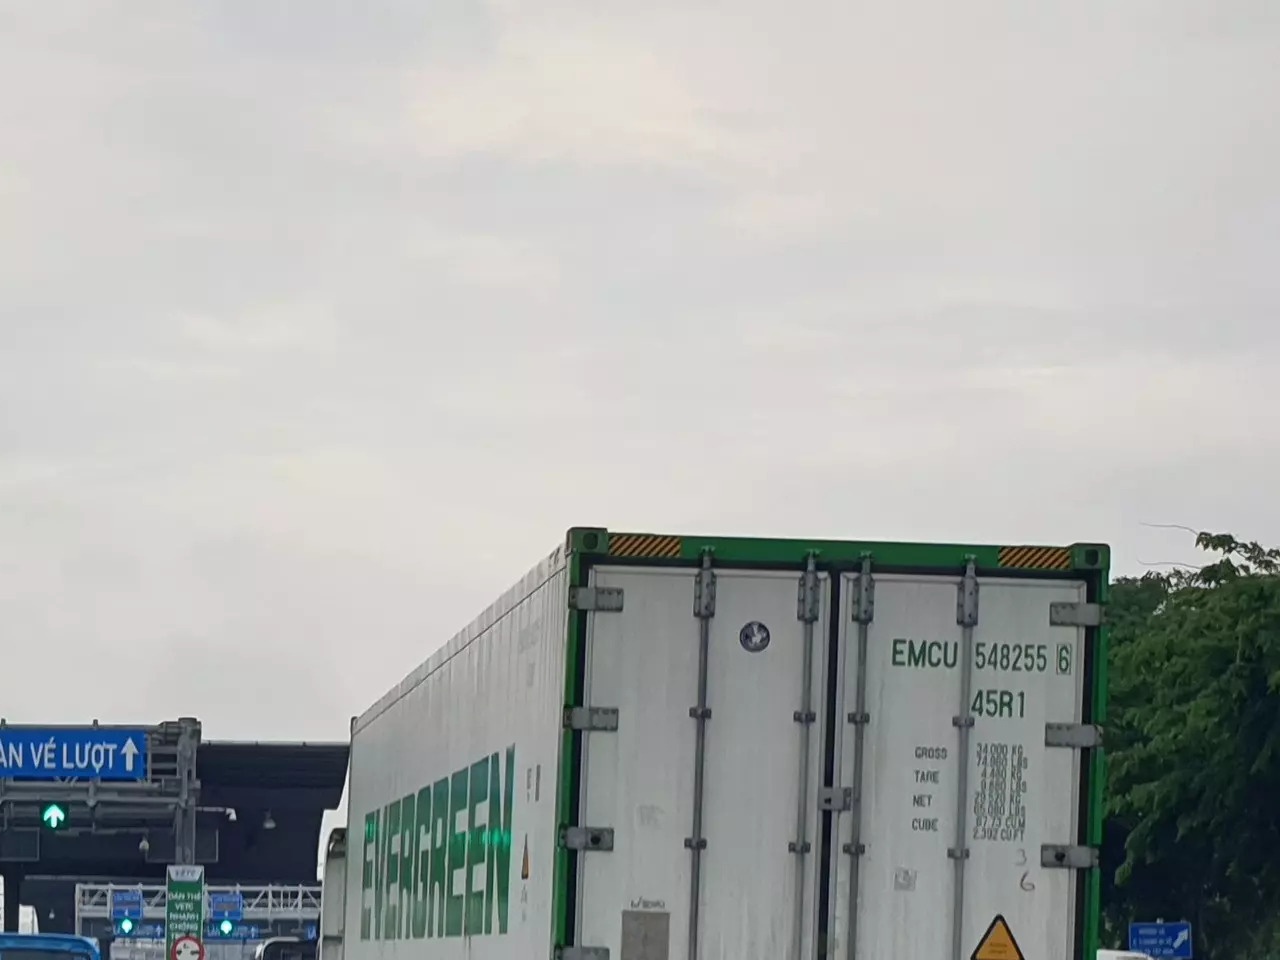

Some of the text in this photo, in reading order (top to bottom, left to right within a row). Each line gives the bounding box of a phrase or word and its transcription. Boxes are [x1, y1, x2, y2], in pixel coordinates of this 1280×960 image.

[892, 639, 1071, 674] EMCU 548255 6
[971, 690, 1025, 718] 45R1
[30, 736, 56, 769] VÉ
[62, 741, 117, 774] LƯỢT
[913, 795, 932, 807] NET
[360, 742, 516, 941] EVERGREEN
